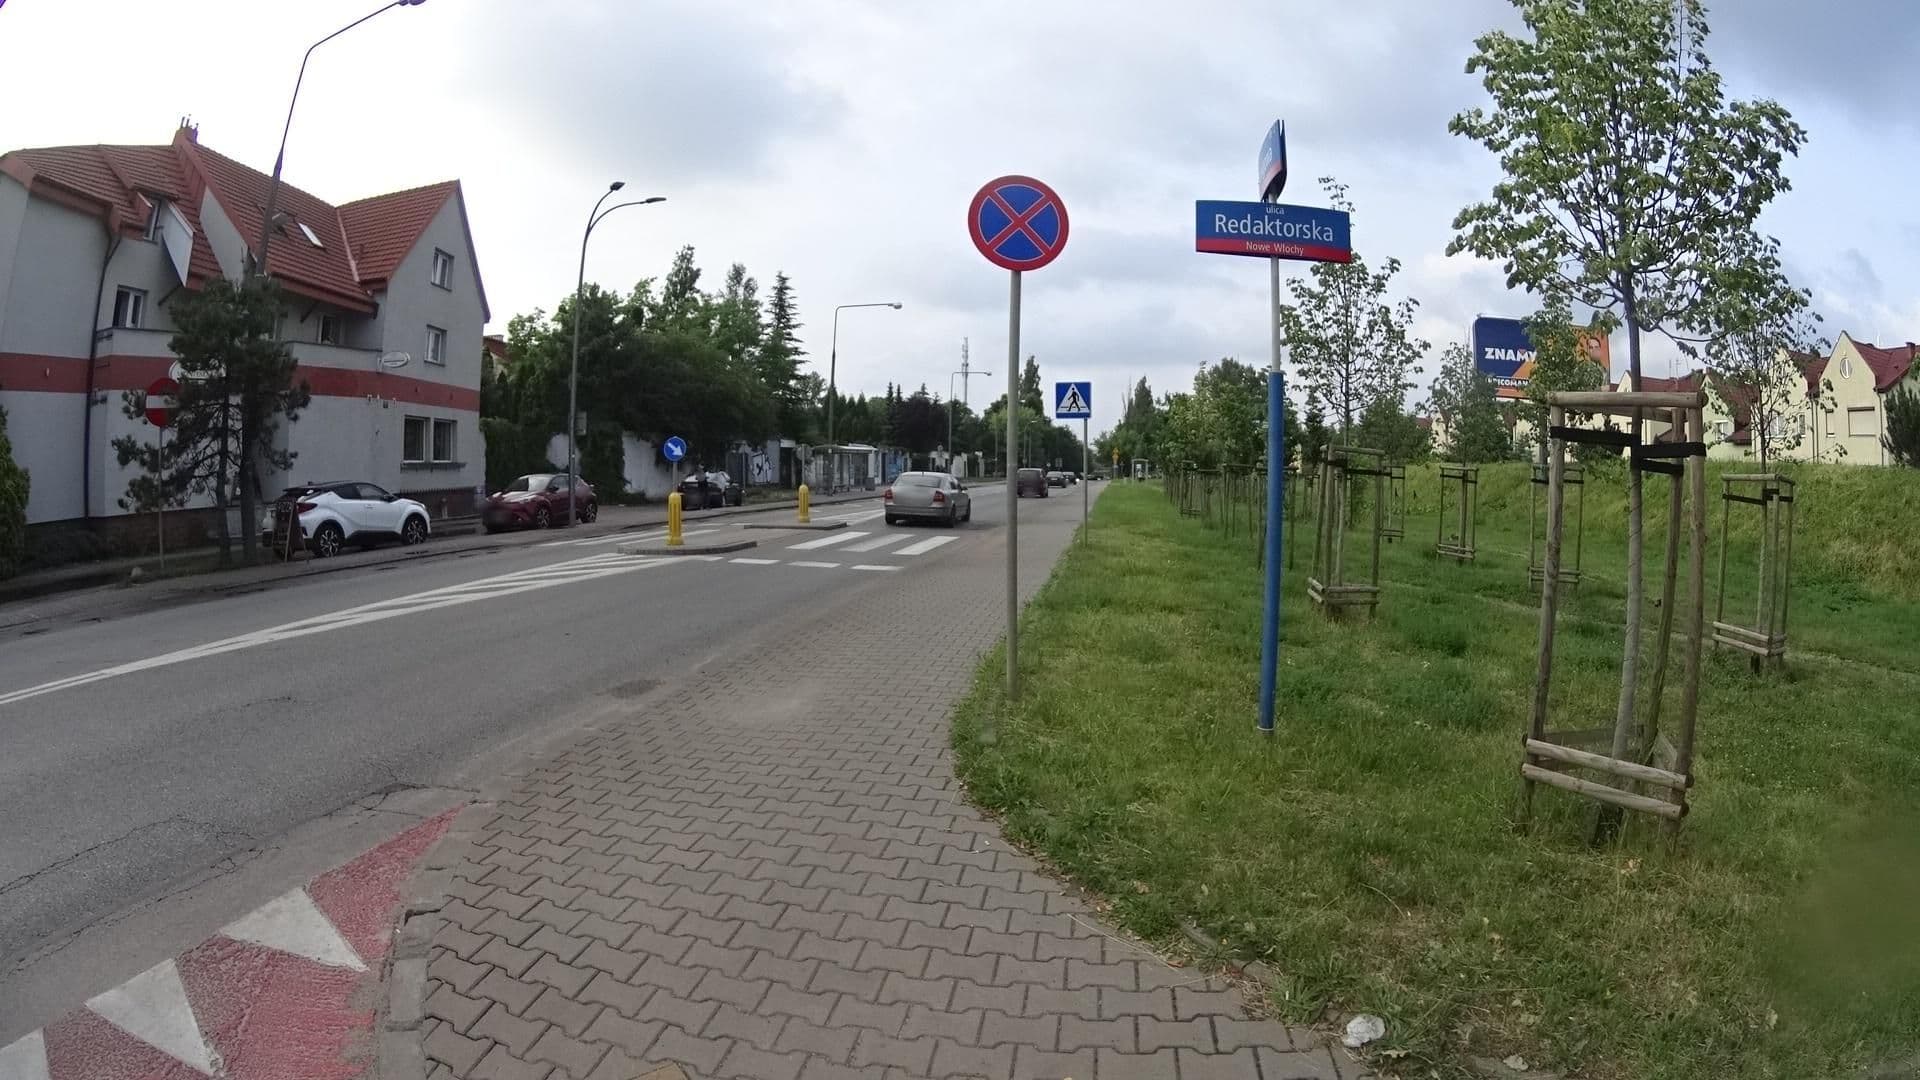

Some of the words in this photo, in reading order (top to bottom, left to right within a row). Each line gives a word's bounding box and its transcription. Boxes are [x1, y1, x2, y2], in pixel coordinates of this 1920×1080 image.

[1266, 205, 1285, 215] ulica
[1215, 213, 1334, 242] Redaktorska
[1246, 241, 1271, 251] Nowe
